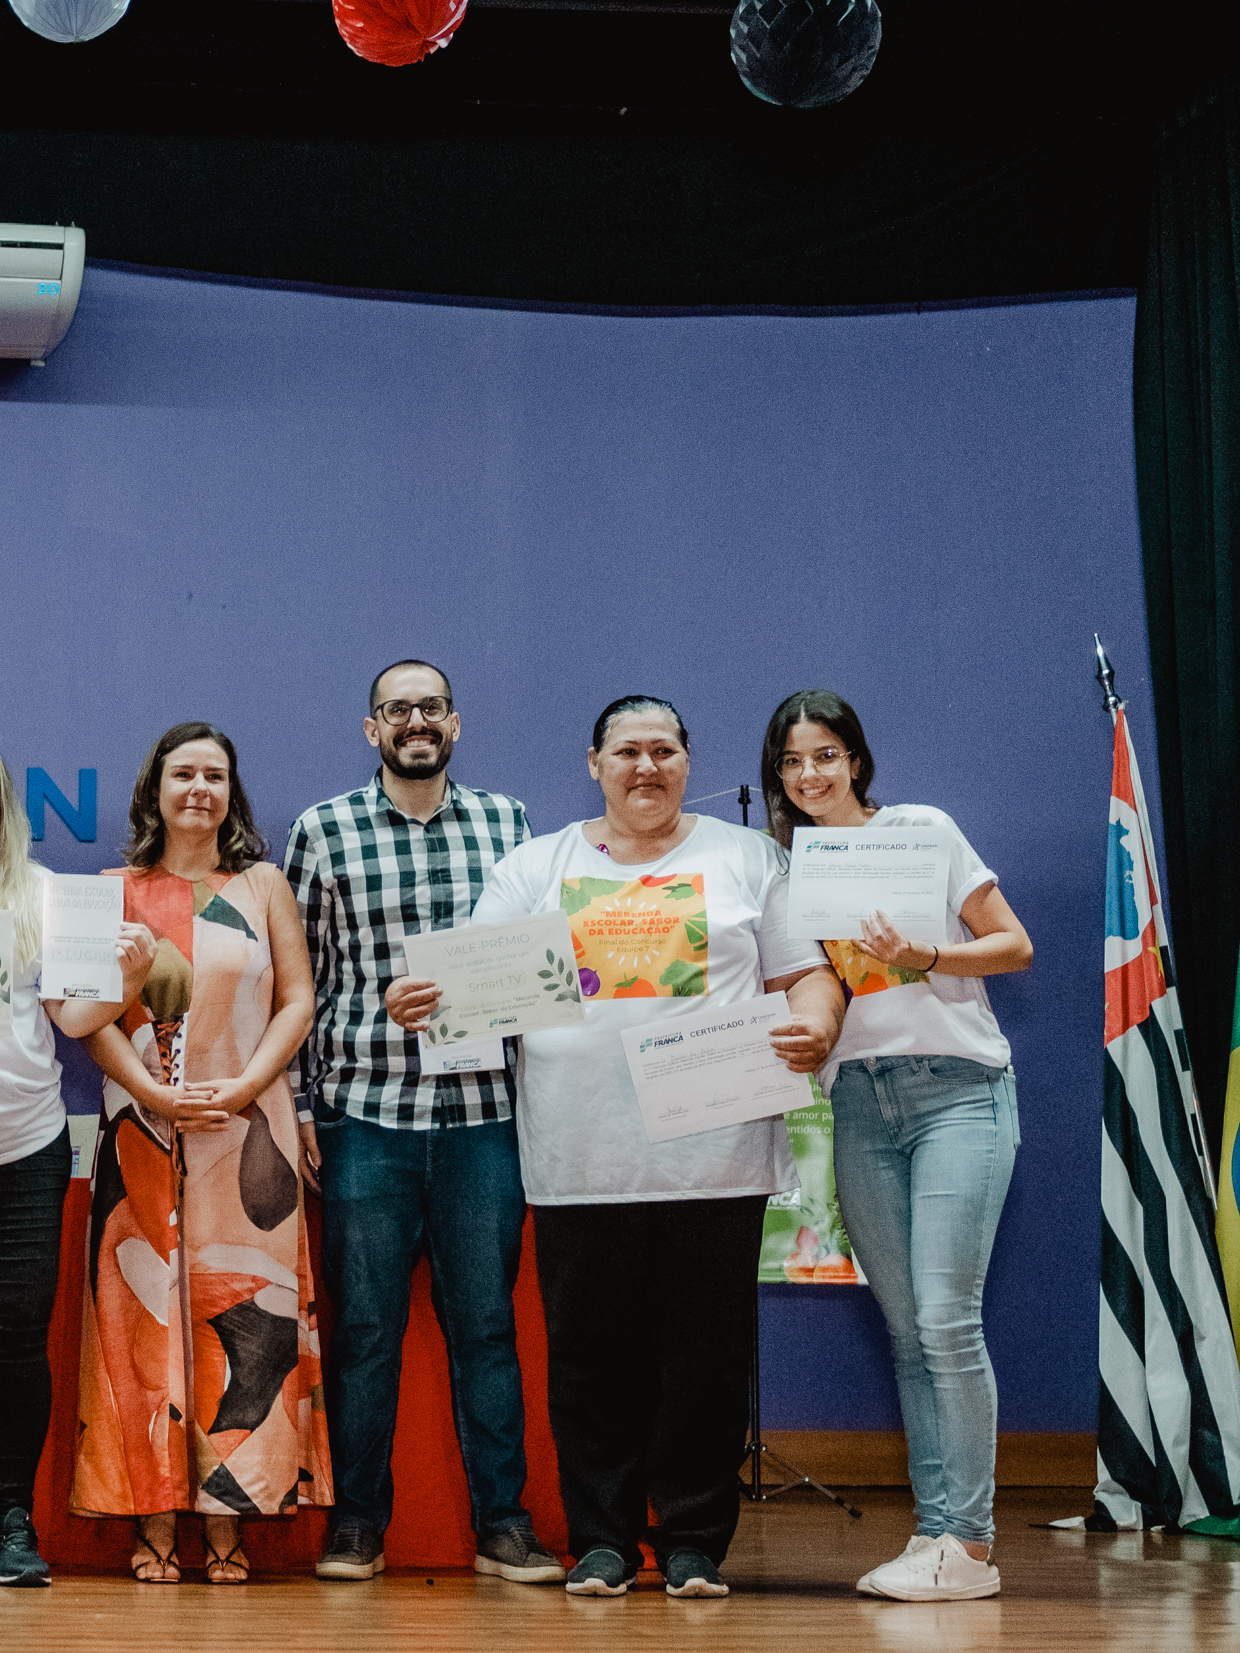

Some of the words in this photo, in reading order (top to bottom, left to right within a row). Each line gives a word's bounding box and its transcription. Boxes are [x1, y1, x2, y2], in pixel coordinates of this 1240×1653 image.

[36, 282, 60, 296] 20
[855, 843, 908, 851] CERTIFICADO
[600, 910, 662, 918] "MERENDA
[583, 919, 638, 928] ESCOLAR,
[641, 916, 680, 926] SABOR
[588, 928, 605, 936] DA
[608, 925, 675, 937] EDUCAÇÃO"
[445, 933, 530, 957] VALE-PRÊMIO
[468, 978, 505, 992] Smart
[507, 974, 522, 985] TV
[690, 1019, 745, 1039] CERTIFICADO
[654, 1035, 684, 1048] FRANCA
[793, 1111, 819, 1120] amor
[822, 1112, 834, 1122] pa
[768, 1187, 801, 1206] NCA
